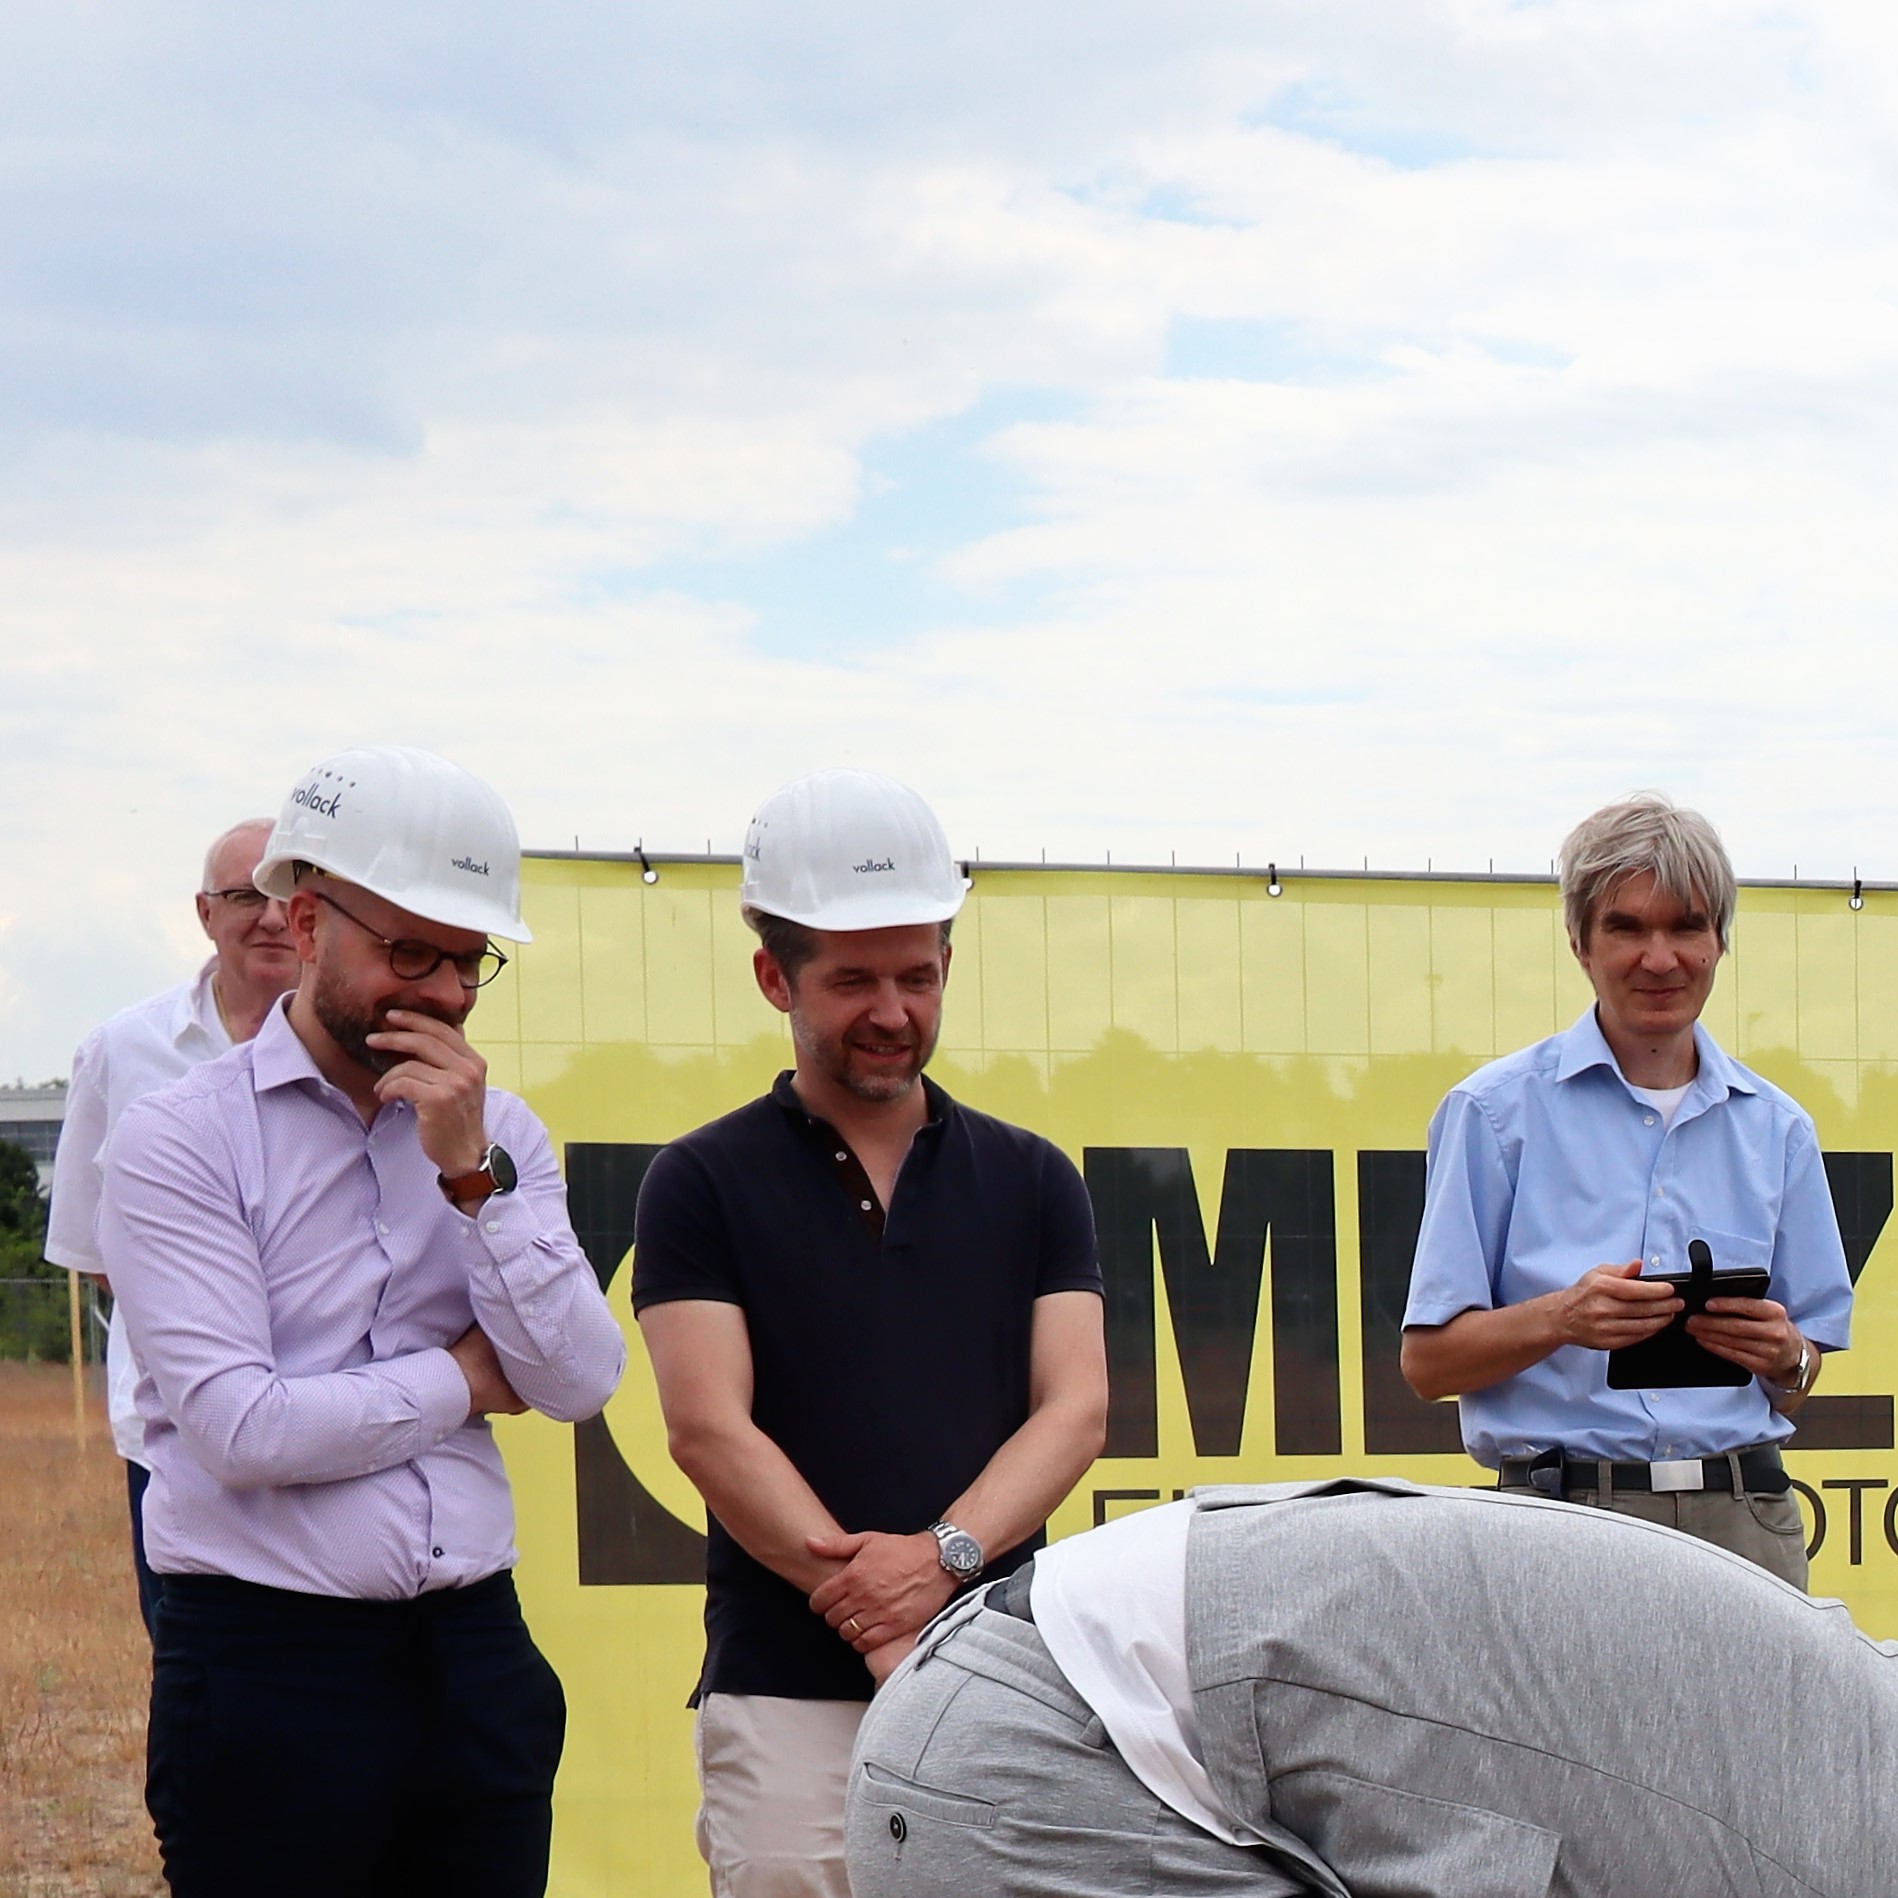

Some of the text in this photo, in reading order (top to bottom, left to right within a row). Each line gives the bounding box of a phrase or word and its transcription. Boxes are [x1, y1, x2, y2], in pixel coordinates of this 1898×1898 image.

[290, 783, 341, 819] vollack
[452, 857, 490, 877] vollack
[853, 858, 895, 874] vollack
